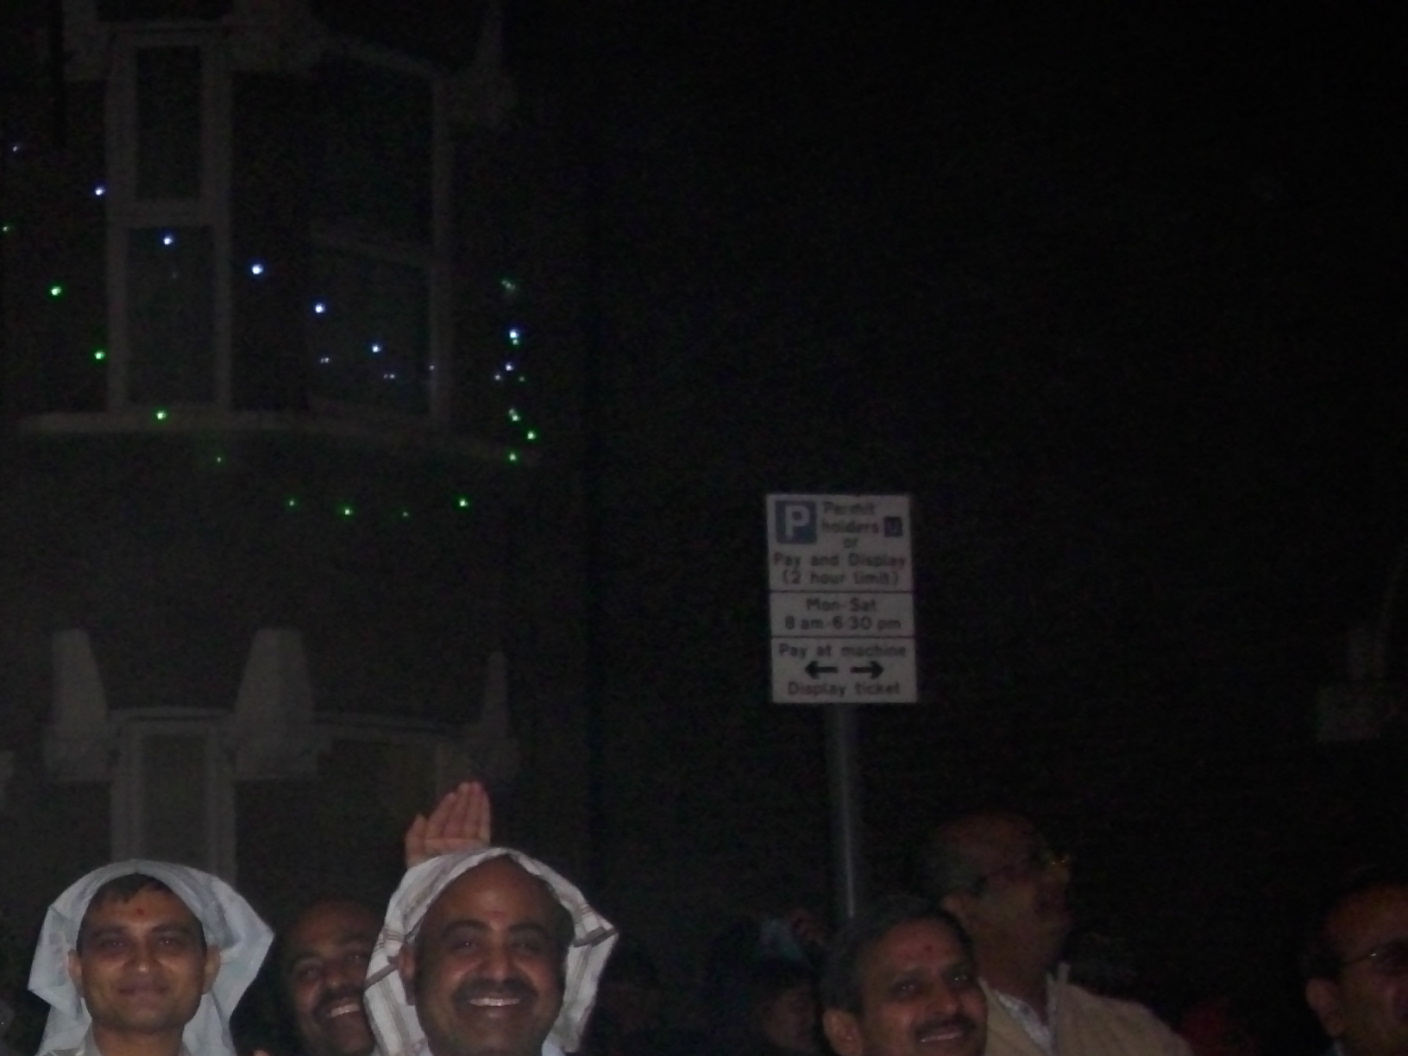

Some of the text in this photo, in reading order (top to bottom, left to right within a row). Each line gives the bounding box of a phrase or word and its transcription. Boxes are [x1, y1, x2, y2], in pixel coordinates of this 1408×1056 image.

[823, 501, 875, 515] Permit
[785, 504, 811, 540] P
[821, 519, 880, 534] holders
[843, 537, 859, 549] or
[773, 551, 906, 570] Pay and Display
[782, 570, 899, 585] (2 hour limit)
[877, 618, 902, 631] pm
[778, 643, 907, 659] Pay at machine
[787, 681, 900, 697] Display ticket
